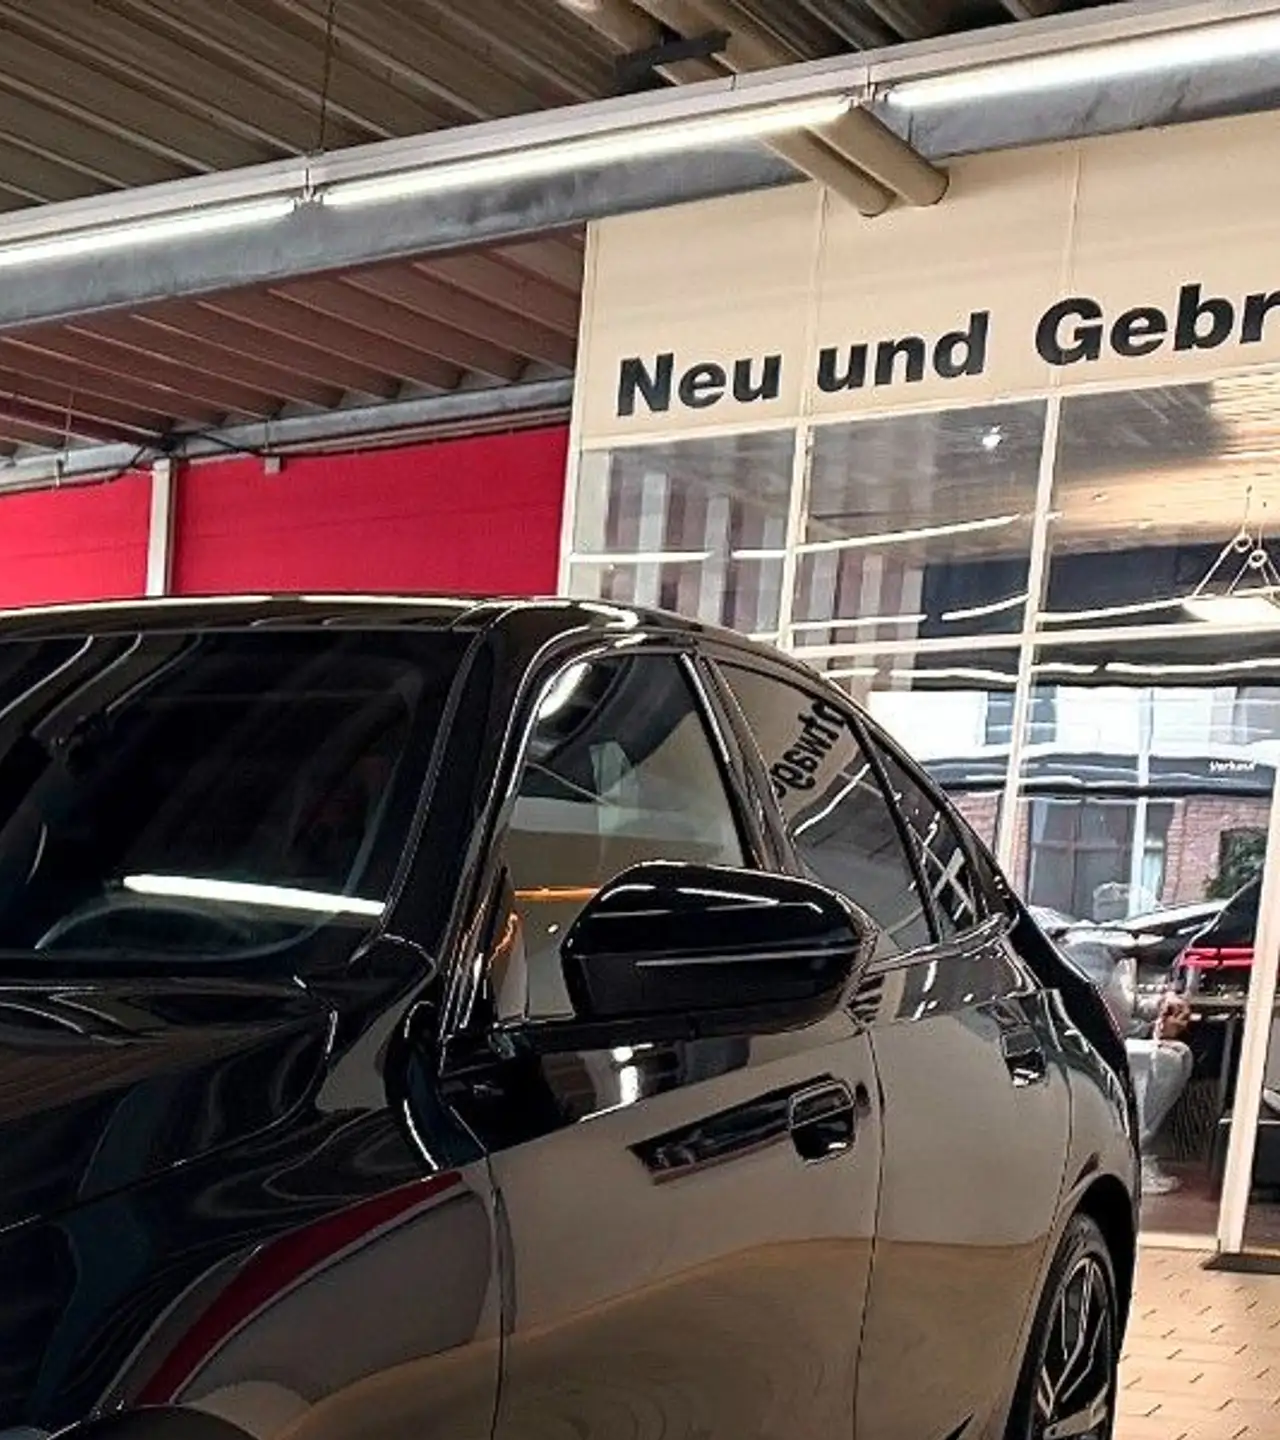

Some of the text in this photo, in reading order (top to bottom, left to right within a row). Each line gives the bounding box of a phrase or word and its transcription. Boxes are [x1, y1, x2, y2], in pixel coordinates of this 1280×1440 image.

[617, 283, 1280, 417] Neu und Gebr
